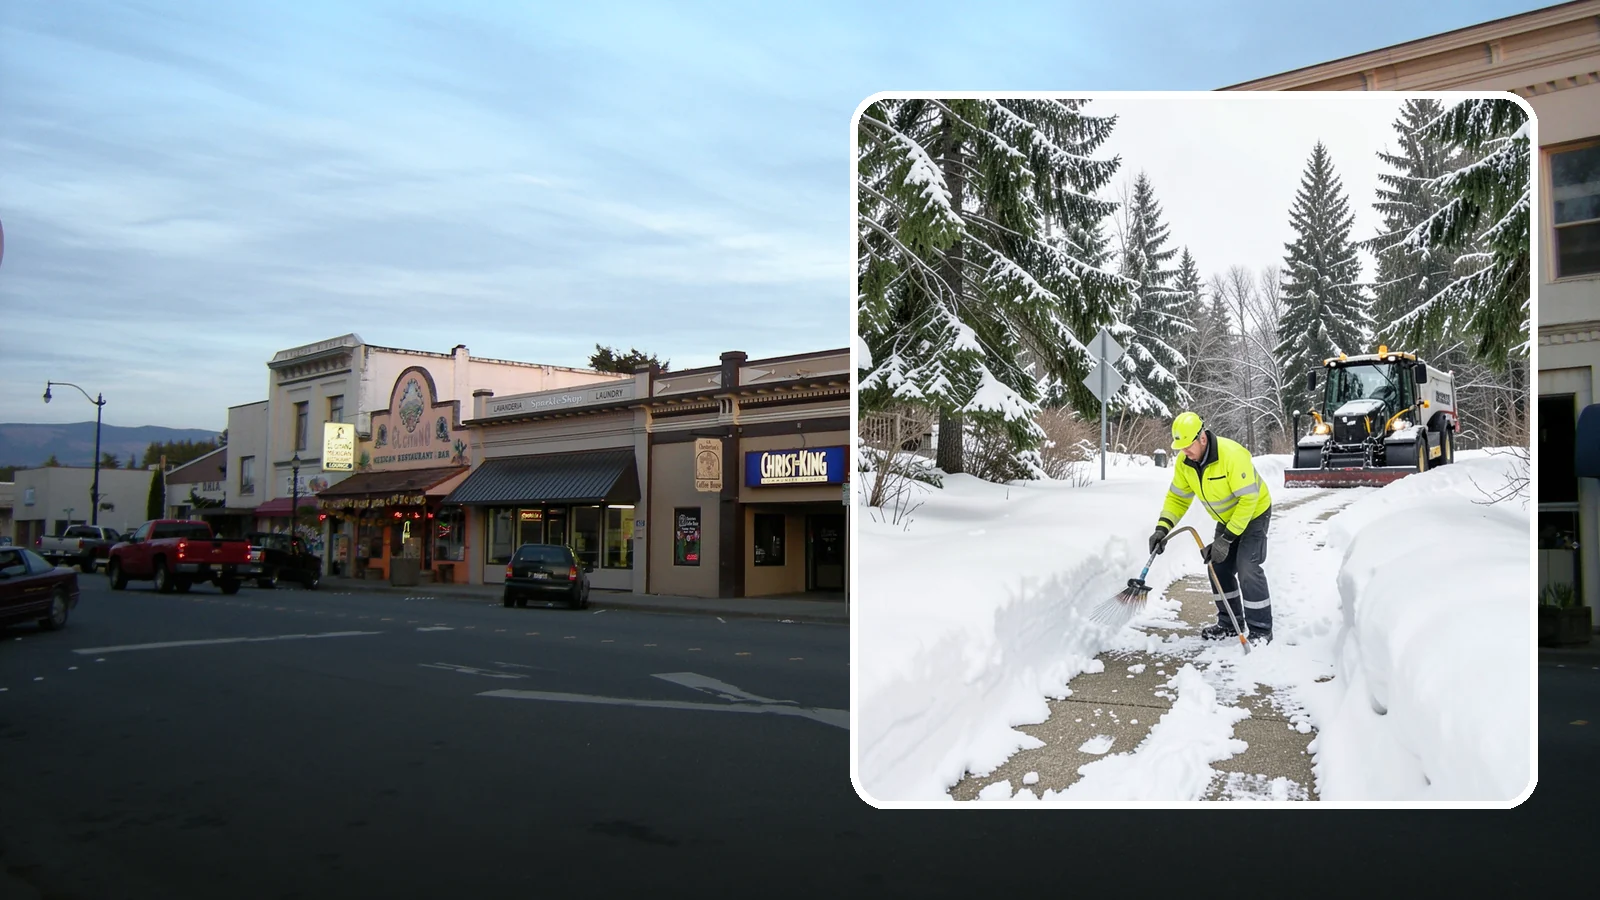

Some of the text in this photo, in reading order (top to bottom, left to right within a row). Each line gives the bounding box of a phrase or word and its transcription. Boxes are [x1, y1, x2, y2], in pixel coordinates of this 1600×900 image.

[562, 394, 582, 405] Shop
[595, 389, 623, 400] LAUNDRY
[494, 402, 522, 412] LAVANDERIA
[375, 456, 396, 464] MEXICAN
[398, 452, 433, 462] RESTAURANT
[438, 450, 450, 459] BAR
[761, 450, 827, 478] CHRIST KING
[696, 481, 709, 489] Coffee
